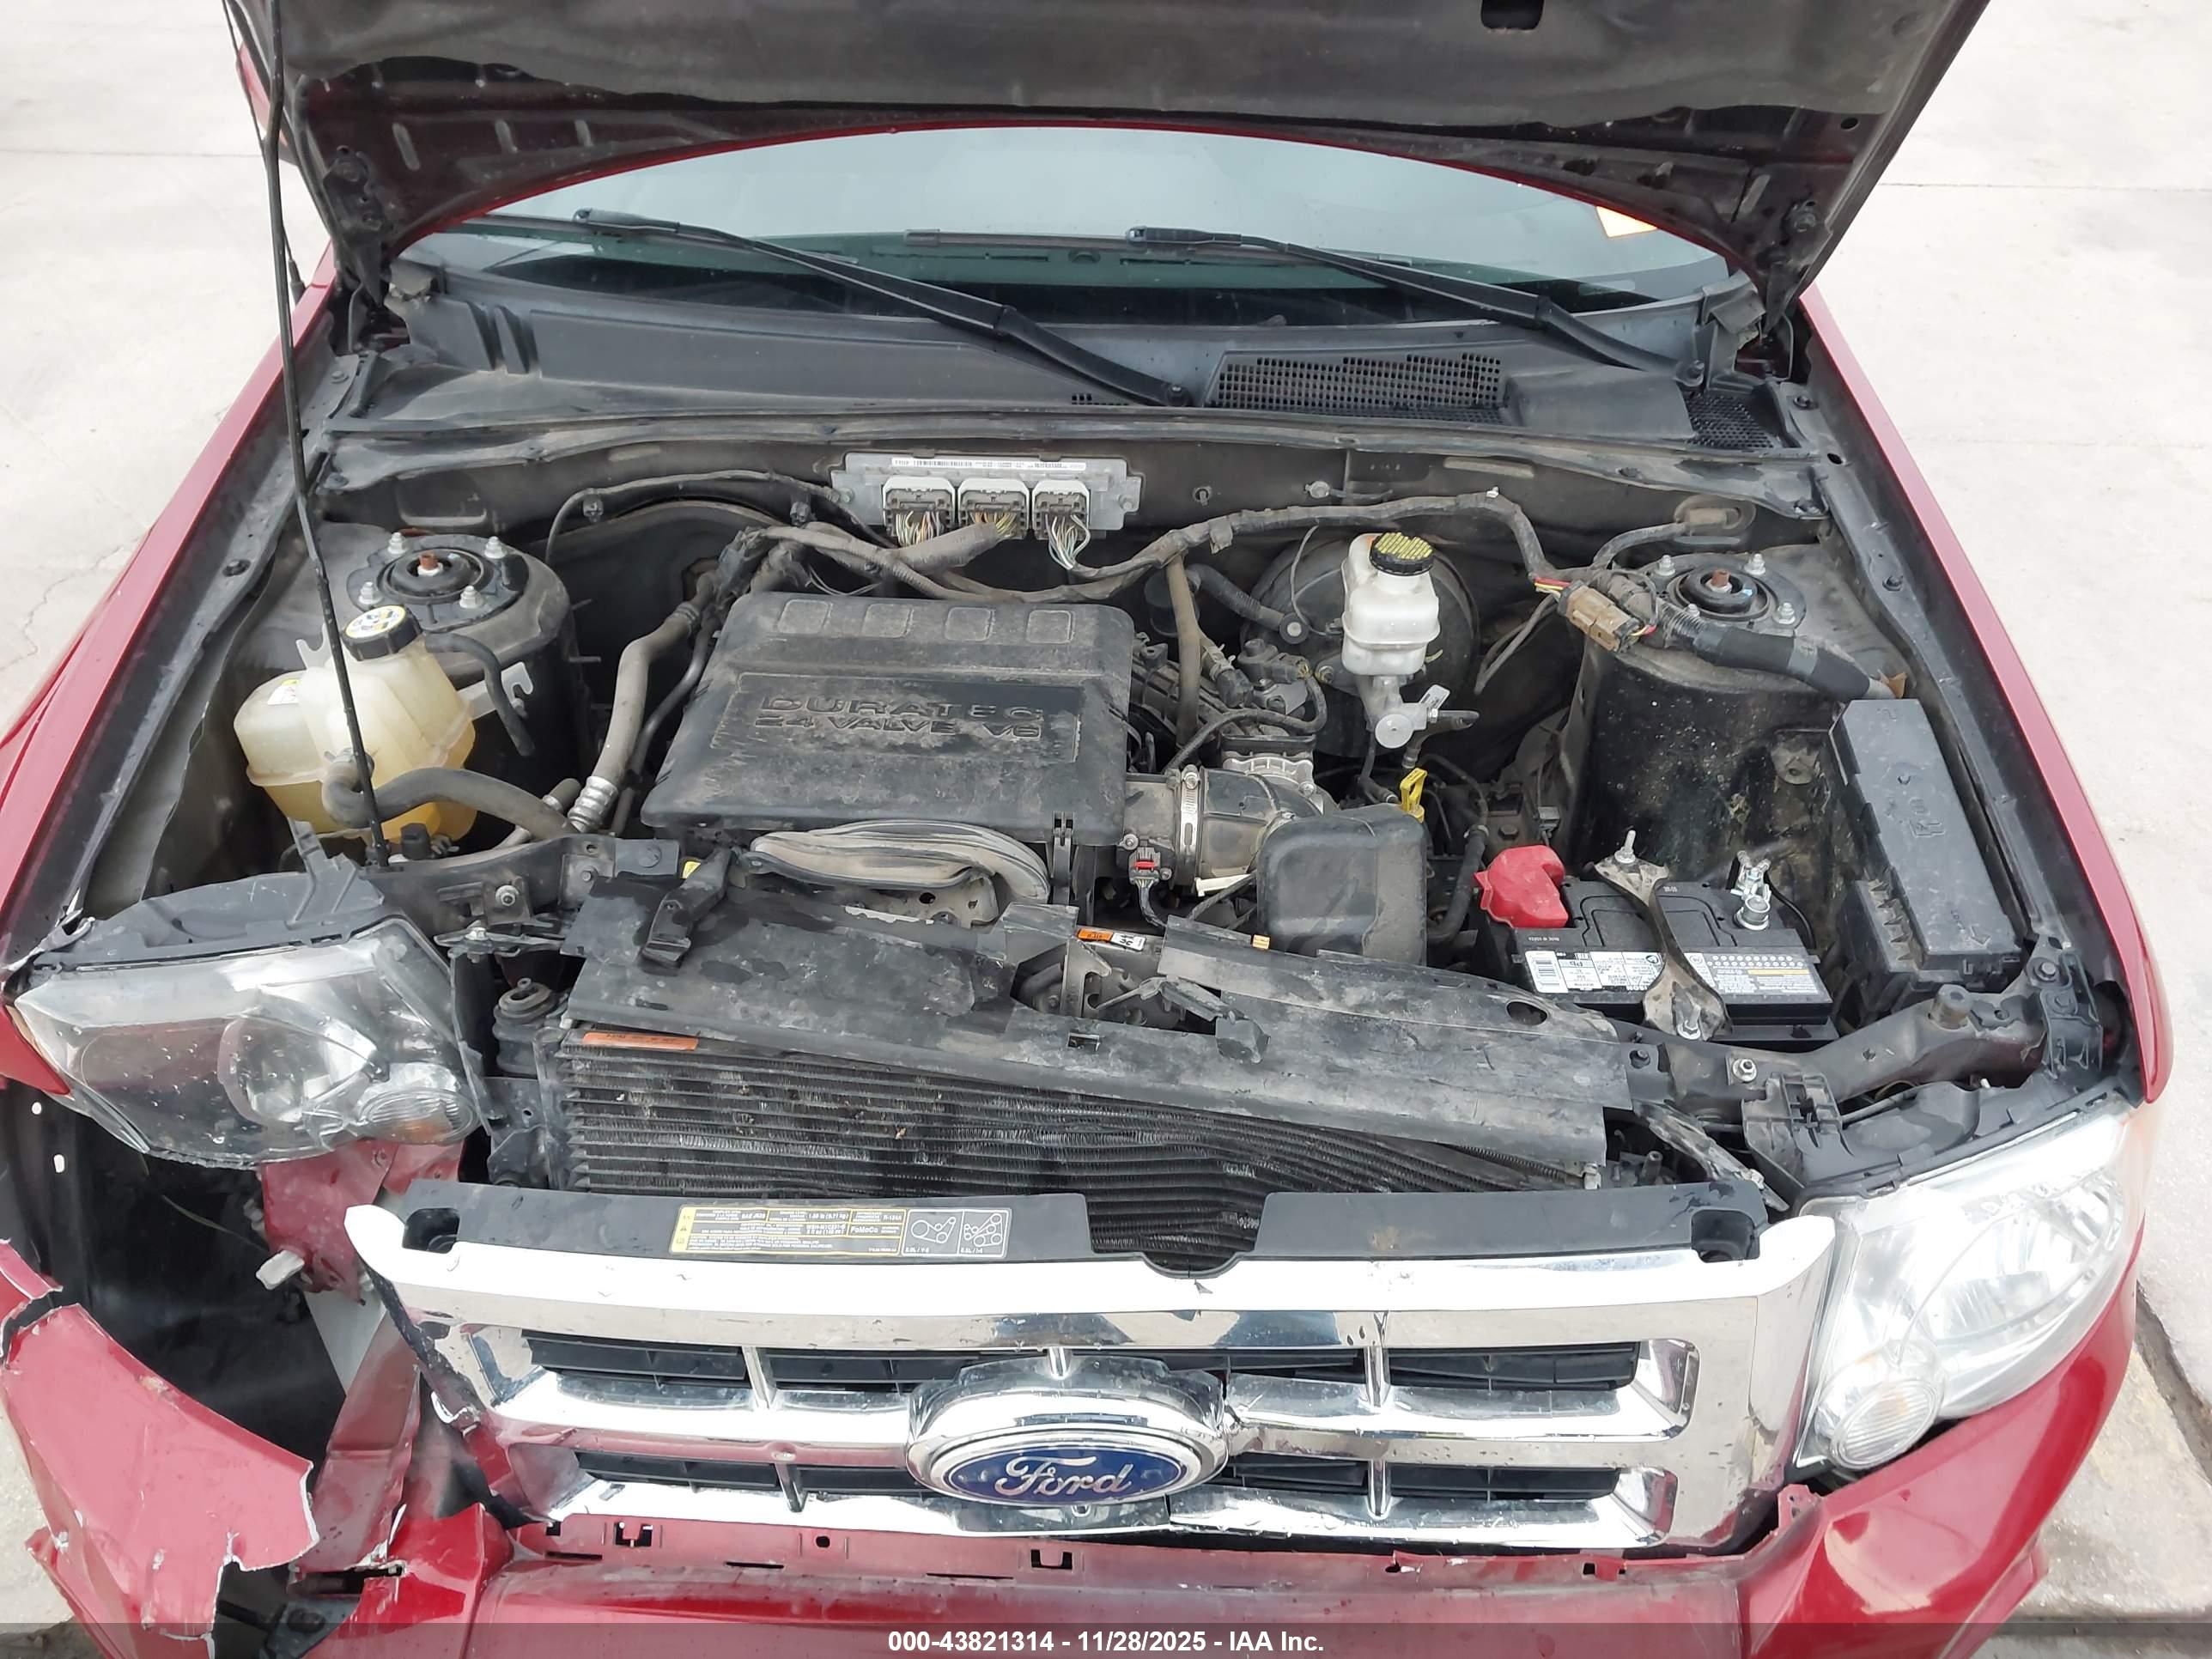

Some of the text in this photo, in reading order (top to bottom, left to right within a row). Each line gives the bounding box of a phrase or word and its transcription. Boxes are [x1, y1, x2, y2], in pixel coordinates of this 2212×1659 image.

[762, 696, 1044, 720] DURATEC
[755, 715, 1041, 739] 24 VALVE V6
[994, 1455, 1133, 1496] Ford
